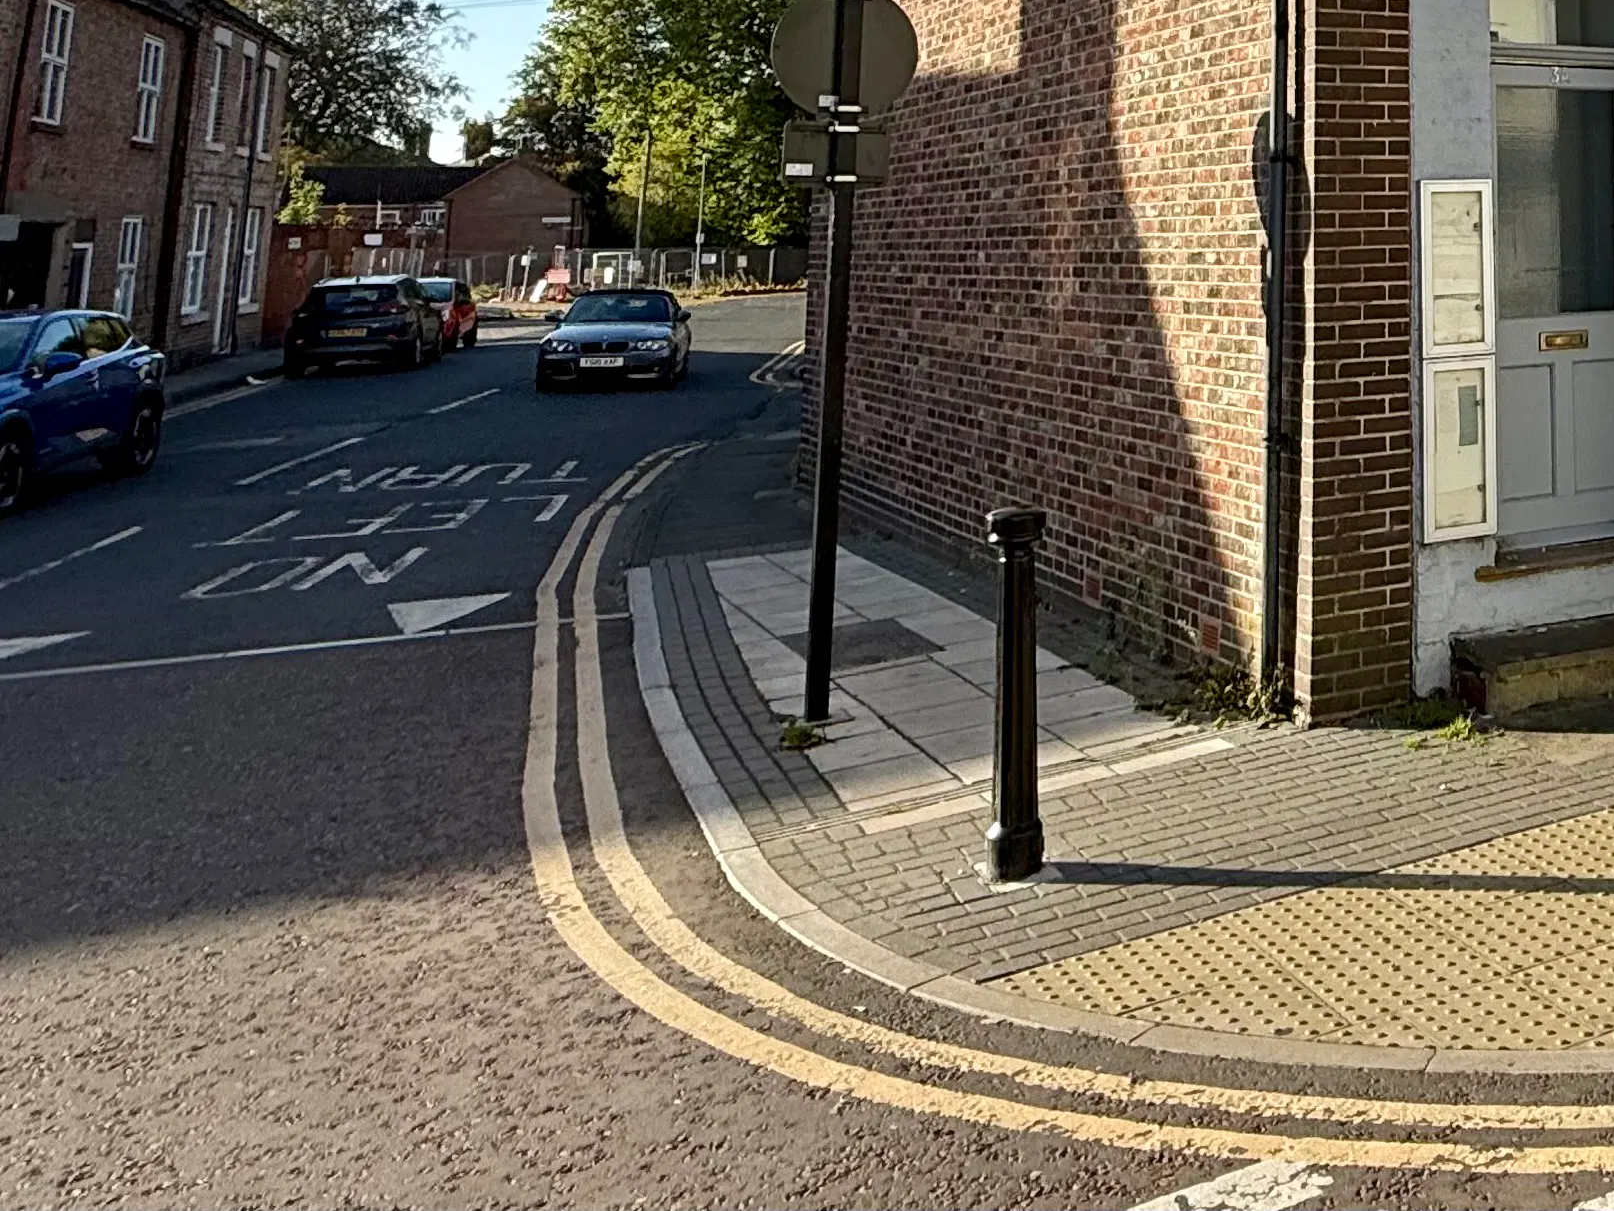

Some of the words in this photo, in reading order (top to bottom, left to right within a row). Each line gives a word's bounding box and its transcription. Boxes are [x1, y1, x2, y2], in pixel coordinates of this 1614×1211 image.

[287, 460, 588, 494] TURN
[191, 494, 569, 549] LEFT
[180, 546, 429, 599] NO
